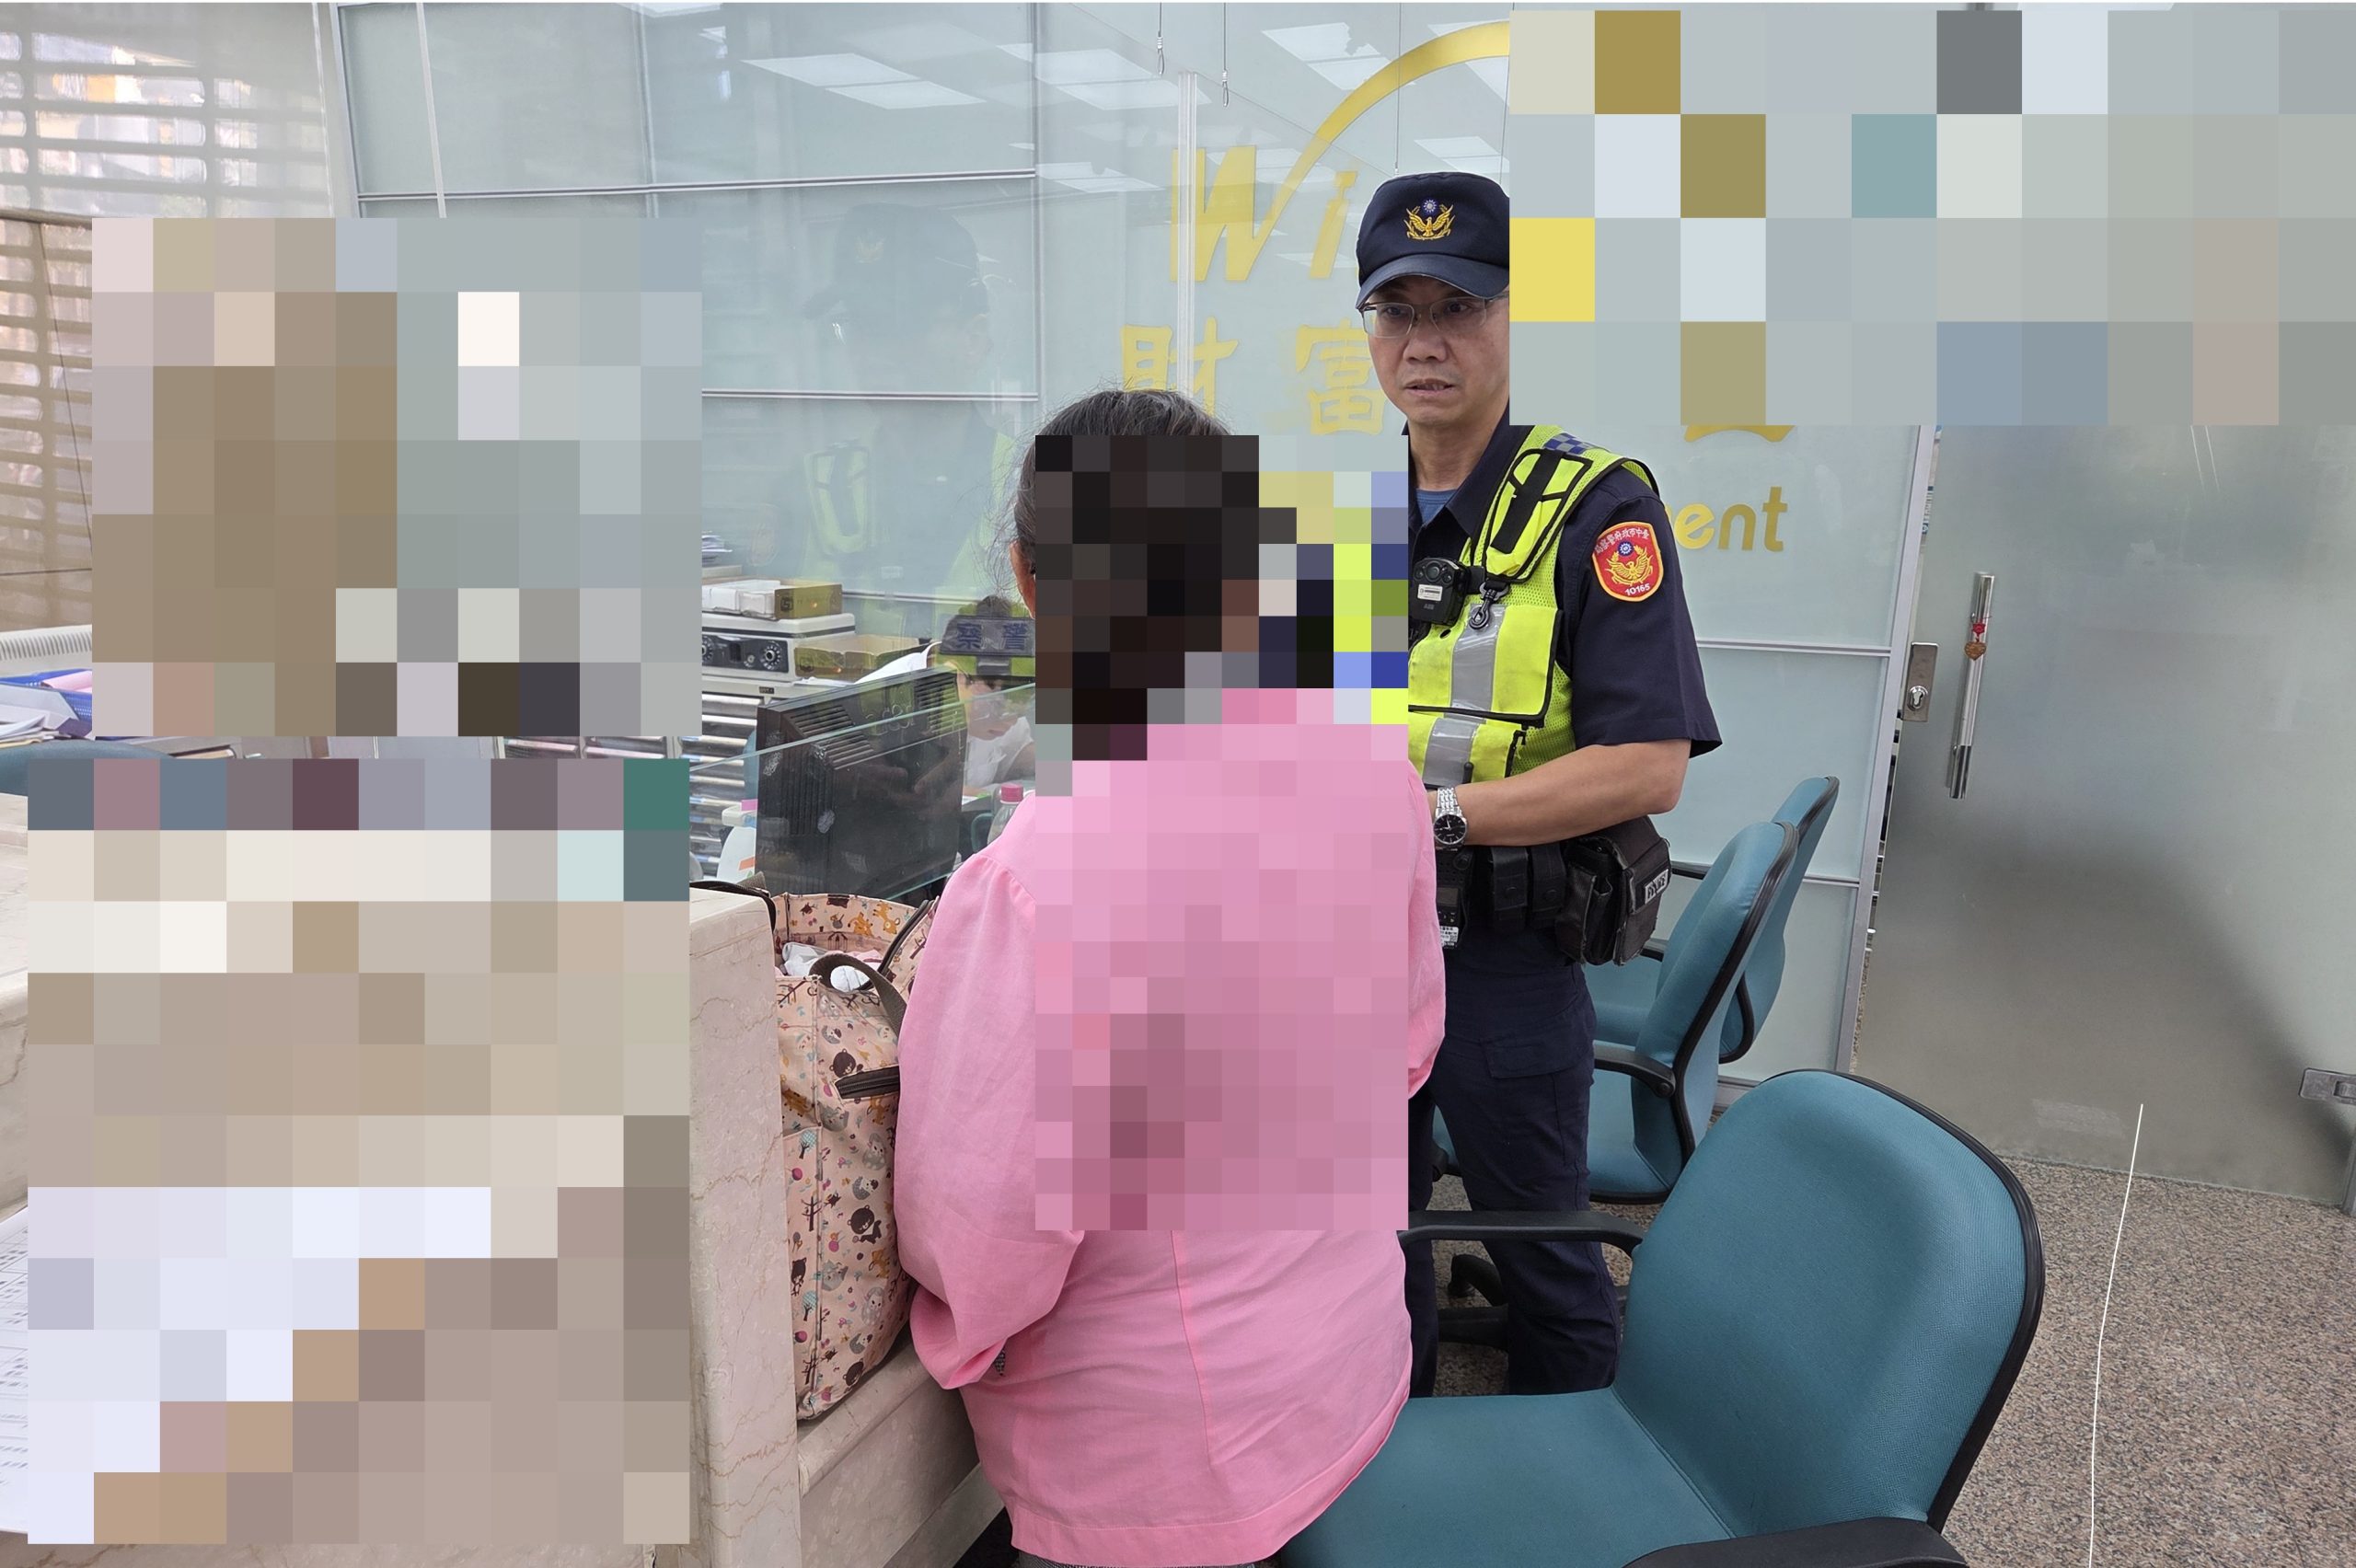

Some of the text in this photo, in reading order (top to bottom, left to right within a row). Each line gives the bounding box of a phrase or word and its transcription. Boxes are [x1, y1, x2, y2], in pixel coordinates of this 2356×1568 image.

[1171, 144, 1358, 281] Wi
[1666, 486, 1788, 552] ent
[1624, 583, 1651, 595] 10165
